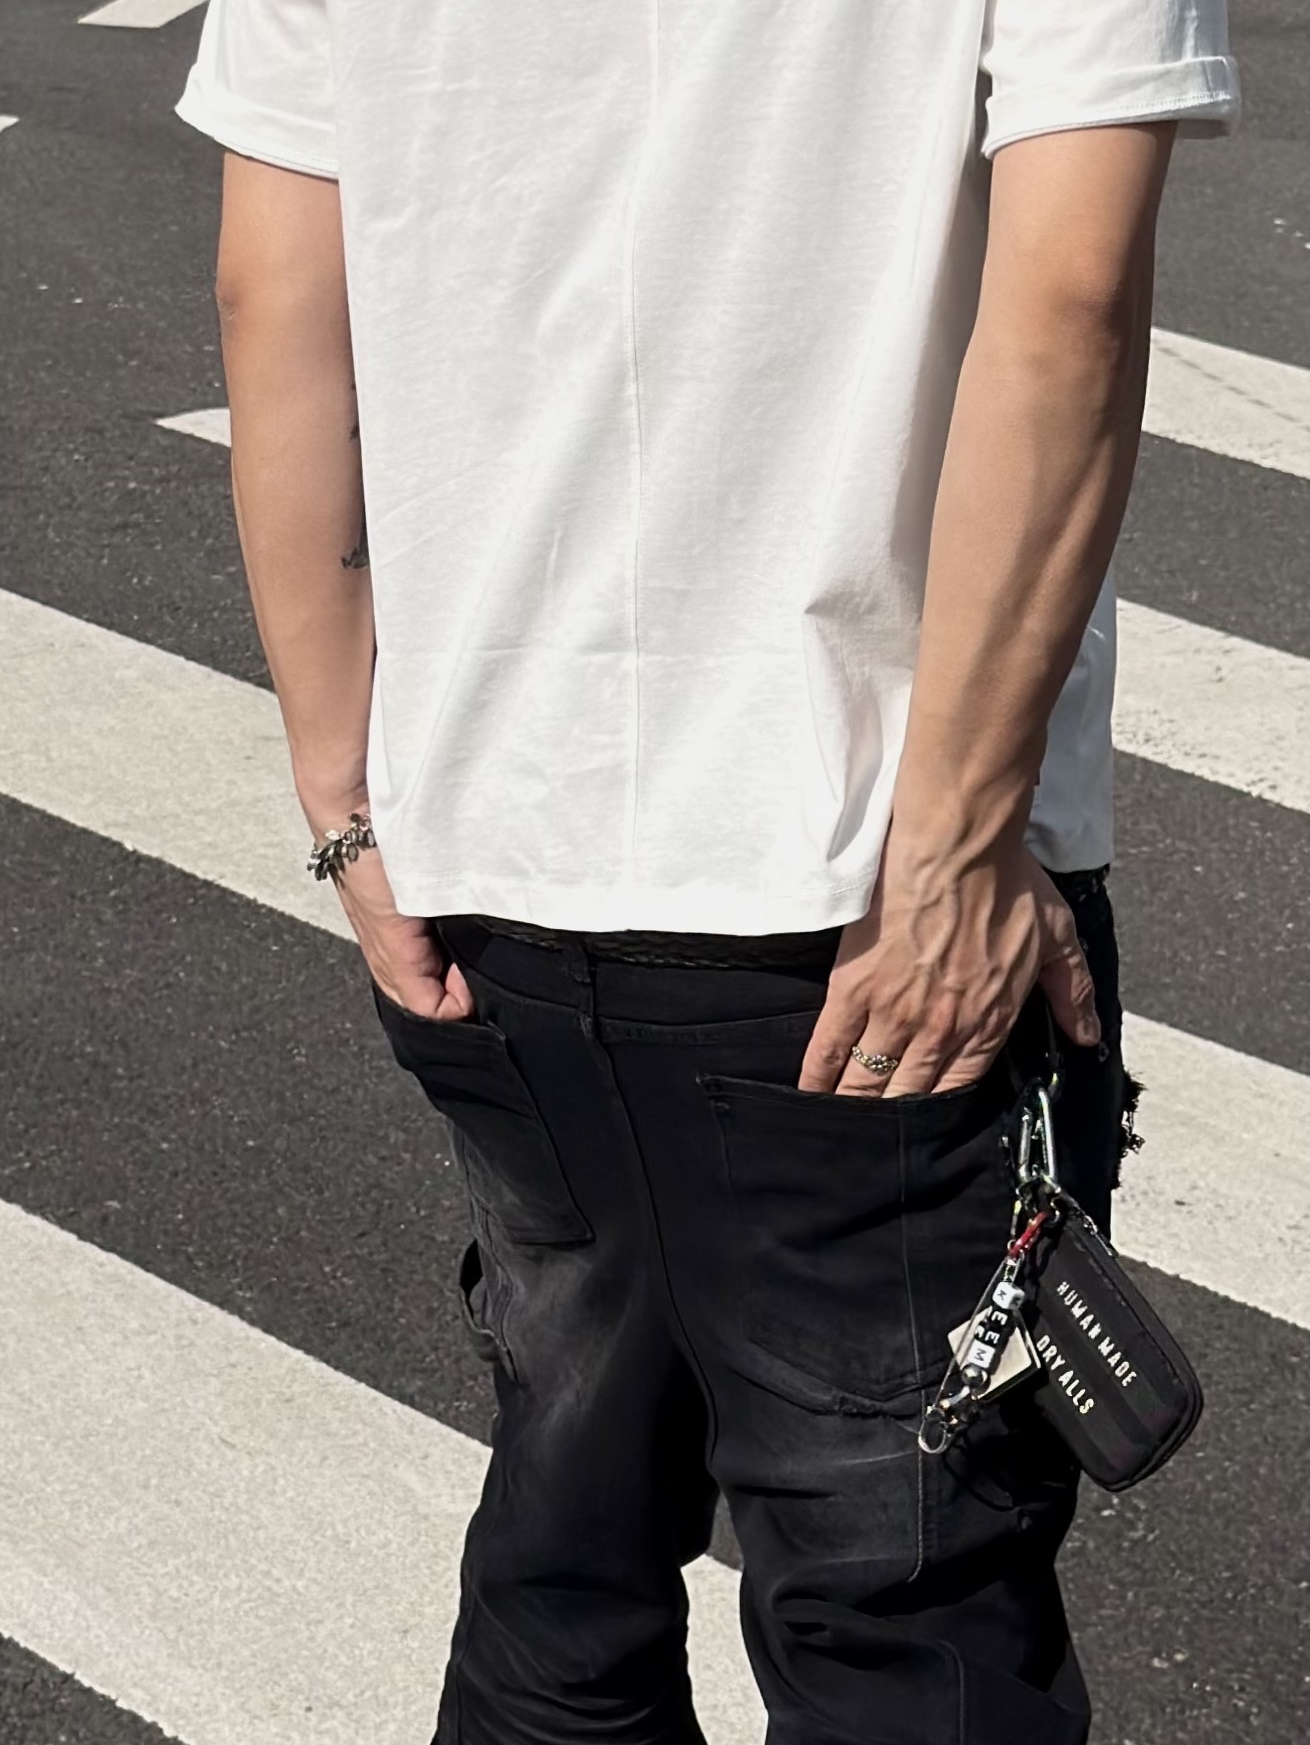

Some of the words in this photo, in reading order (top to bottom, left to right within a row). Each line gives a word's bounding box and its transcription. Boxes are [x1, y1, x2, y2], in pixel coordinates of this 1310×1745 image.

[1036, 1334, 1066, 1371] DRY
[1057, 1369, 1095, 1414] ALLS
[1056, 1281, 1102, 1339] HUMAN
[1097, 1336, 1137, 1387] MADE
